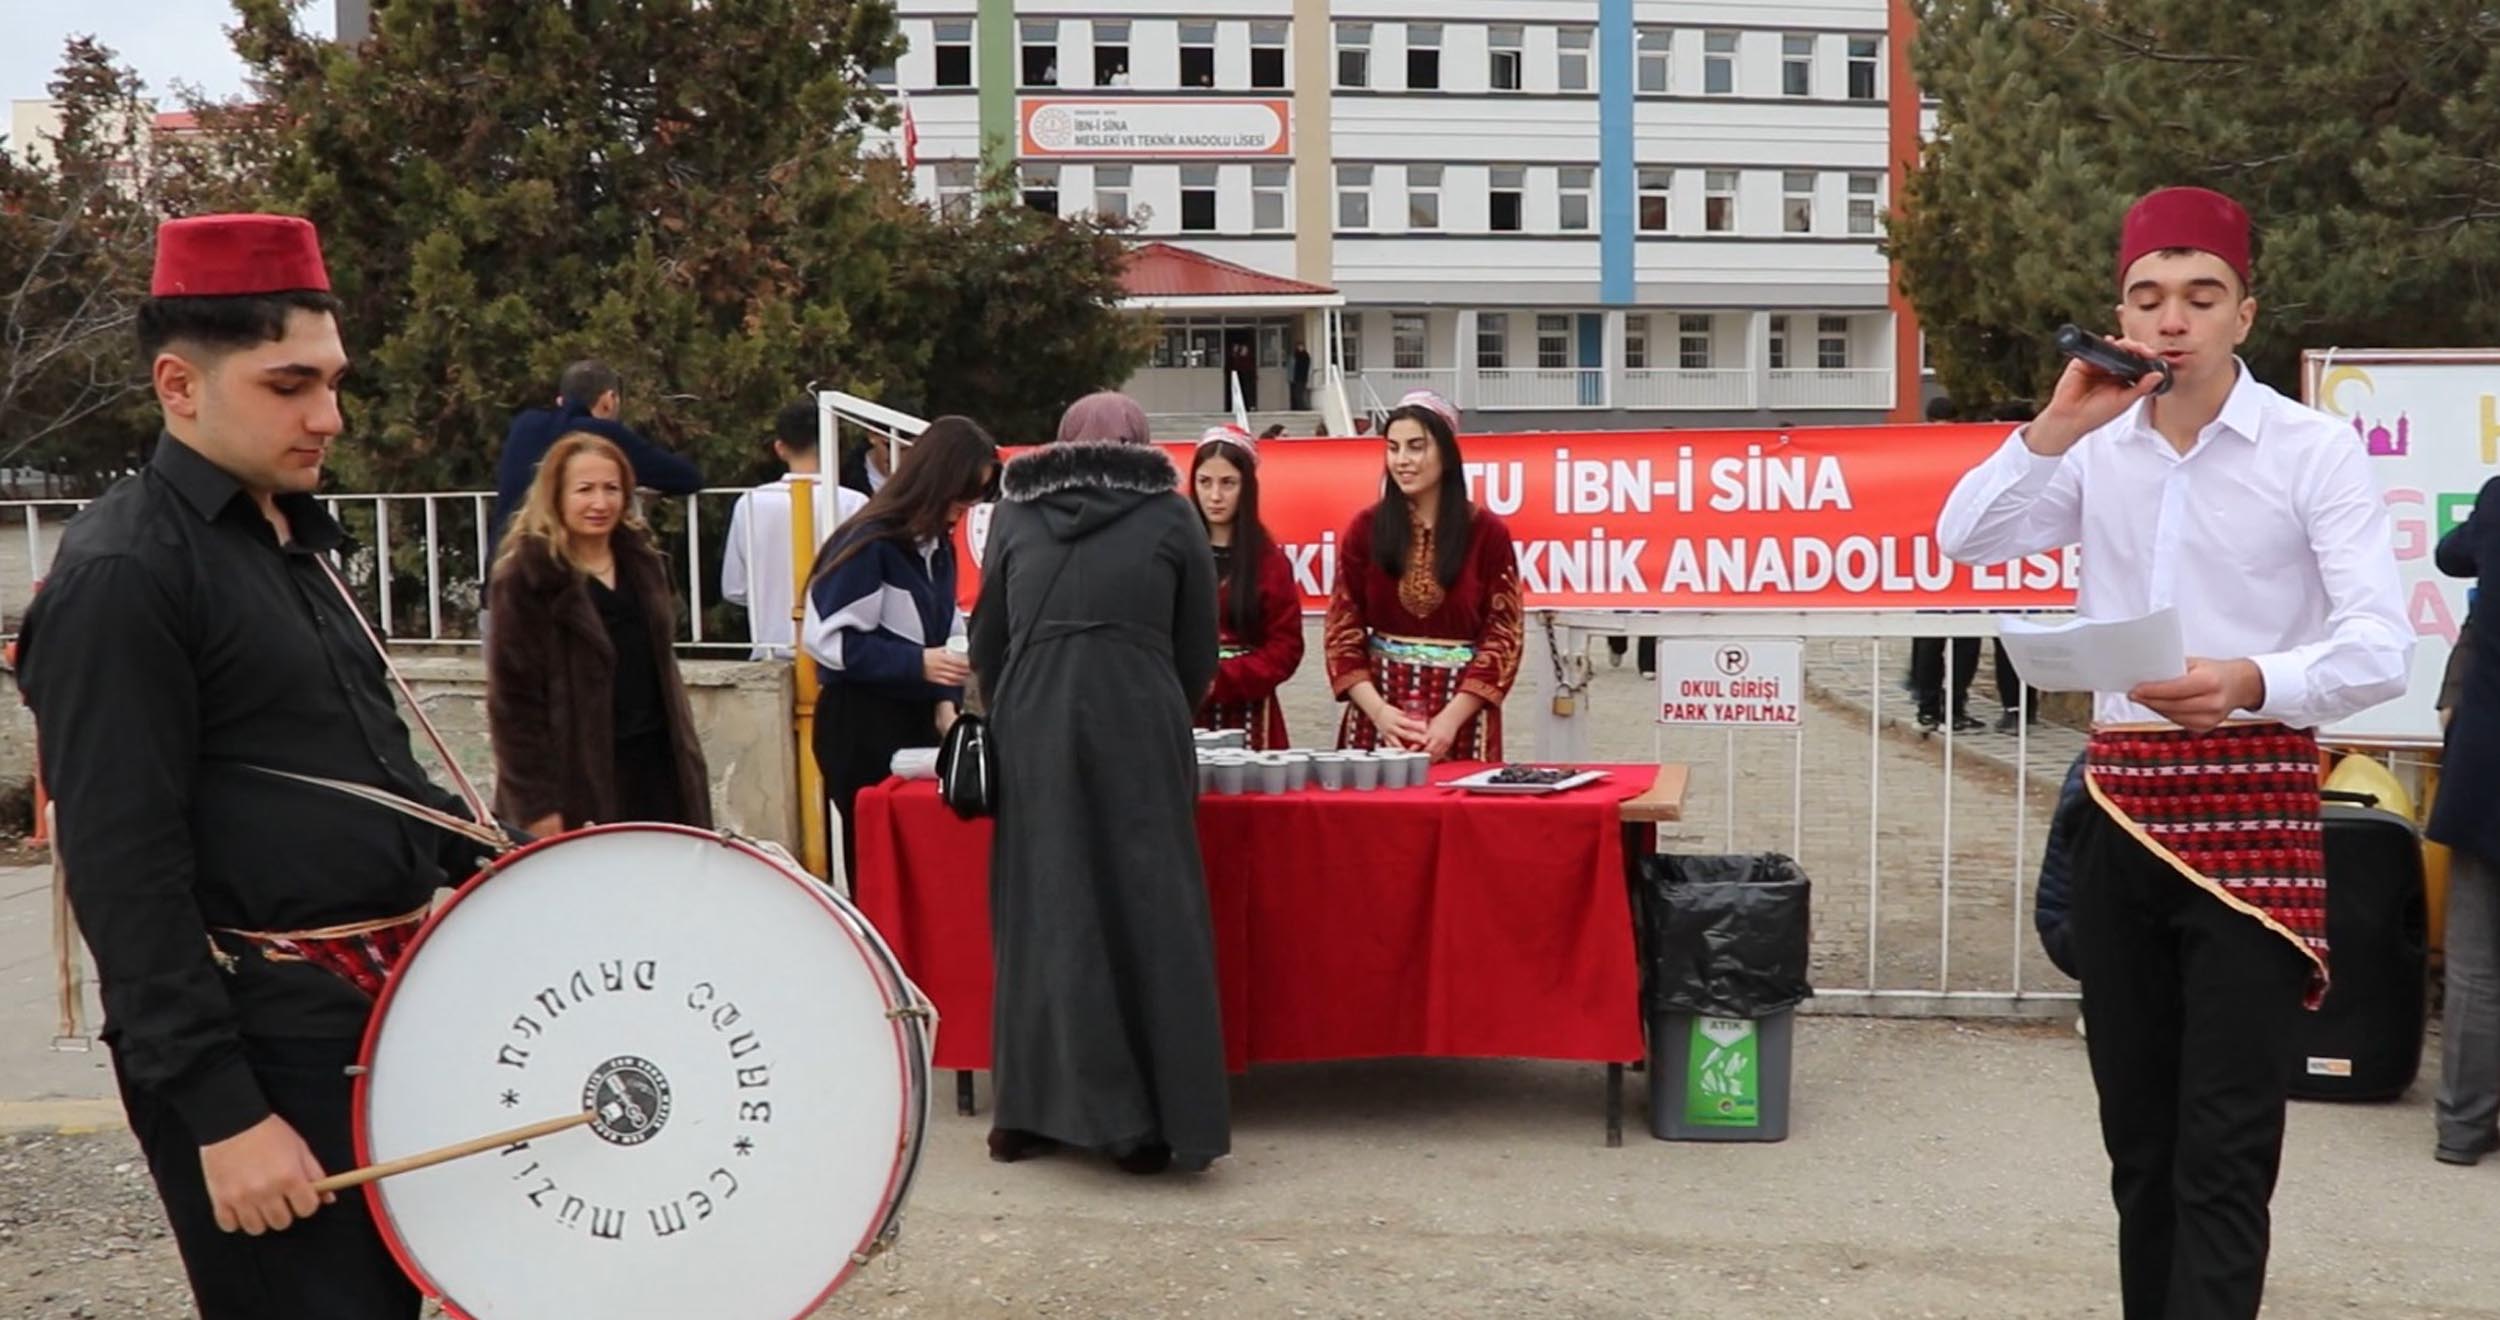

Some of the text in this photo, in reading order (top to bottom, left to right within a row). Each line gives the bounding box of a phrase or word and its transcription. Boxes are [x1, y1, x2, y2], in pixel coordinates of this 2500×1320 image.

[1074, 117, 1128, 131] İBN-İ SİNA
[1074, 132, 1265, 146] MESLEKİ VE TEKNİK ANADOLU LİSESİ
[1555, 447, 1693, 514] İBN-İ
[1709, 444, 1852, 512] SİNA
[1511, 527, 1649, 593] KNİK
[1661, 535, 1954, 592] ANADOLU
[1680, 676, 1780, 702] OKUL GİRİŞİ
[1663, 702, 1797, 722] PARK YAPILMAZ
